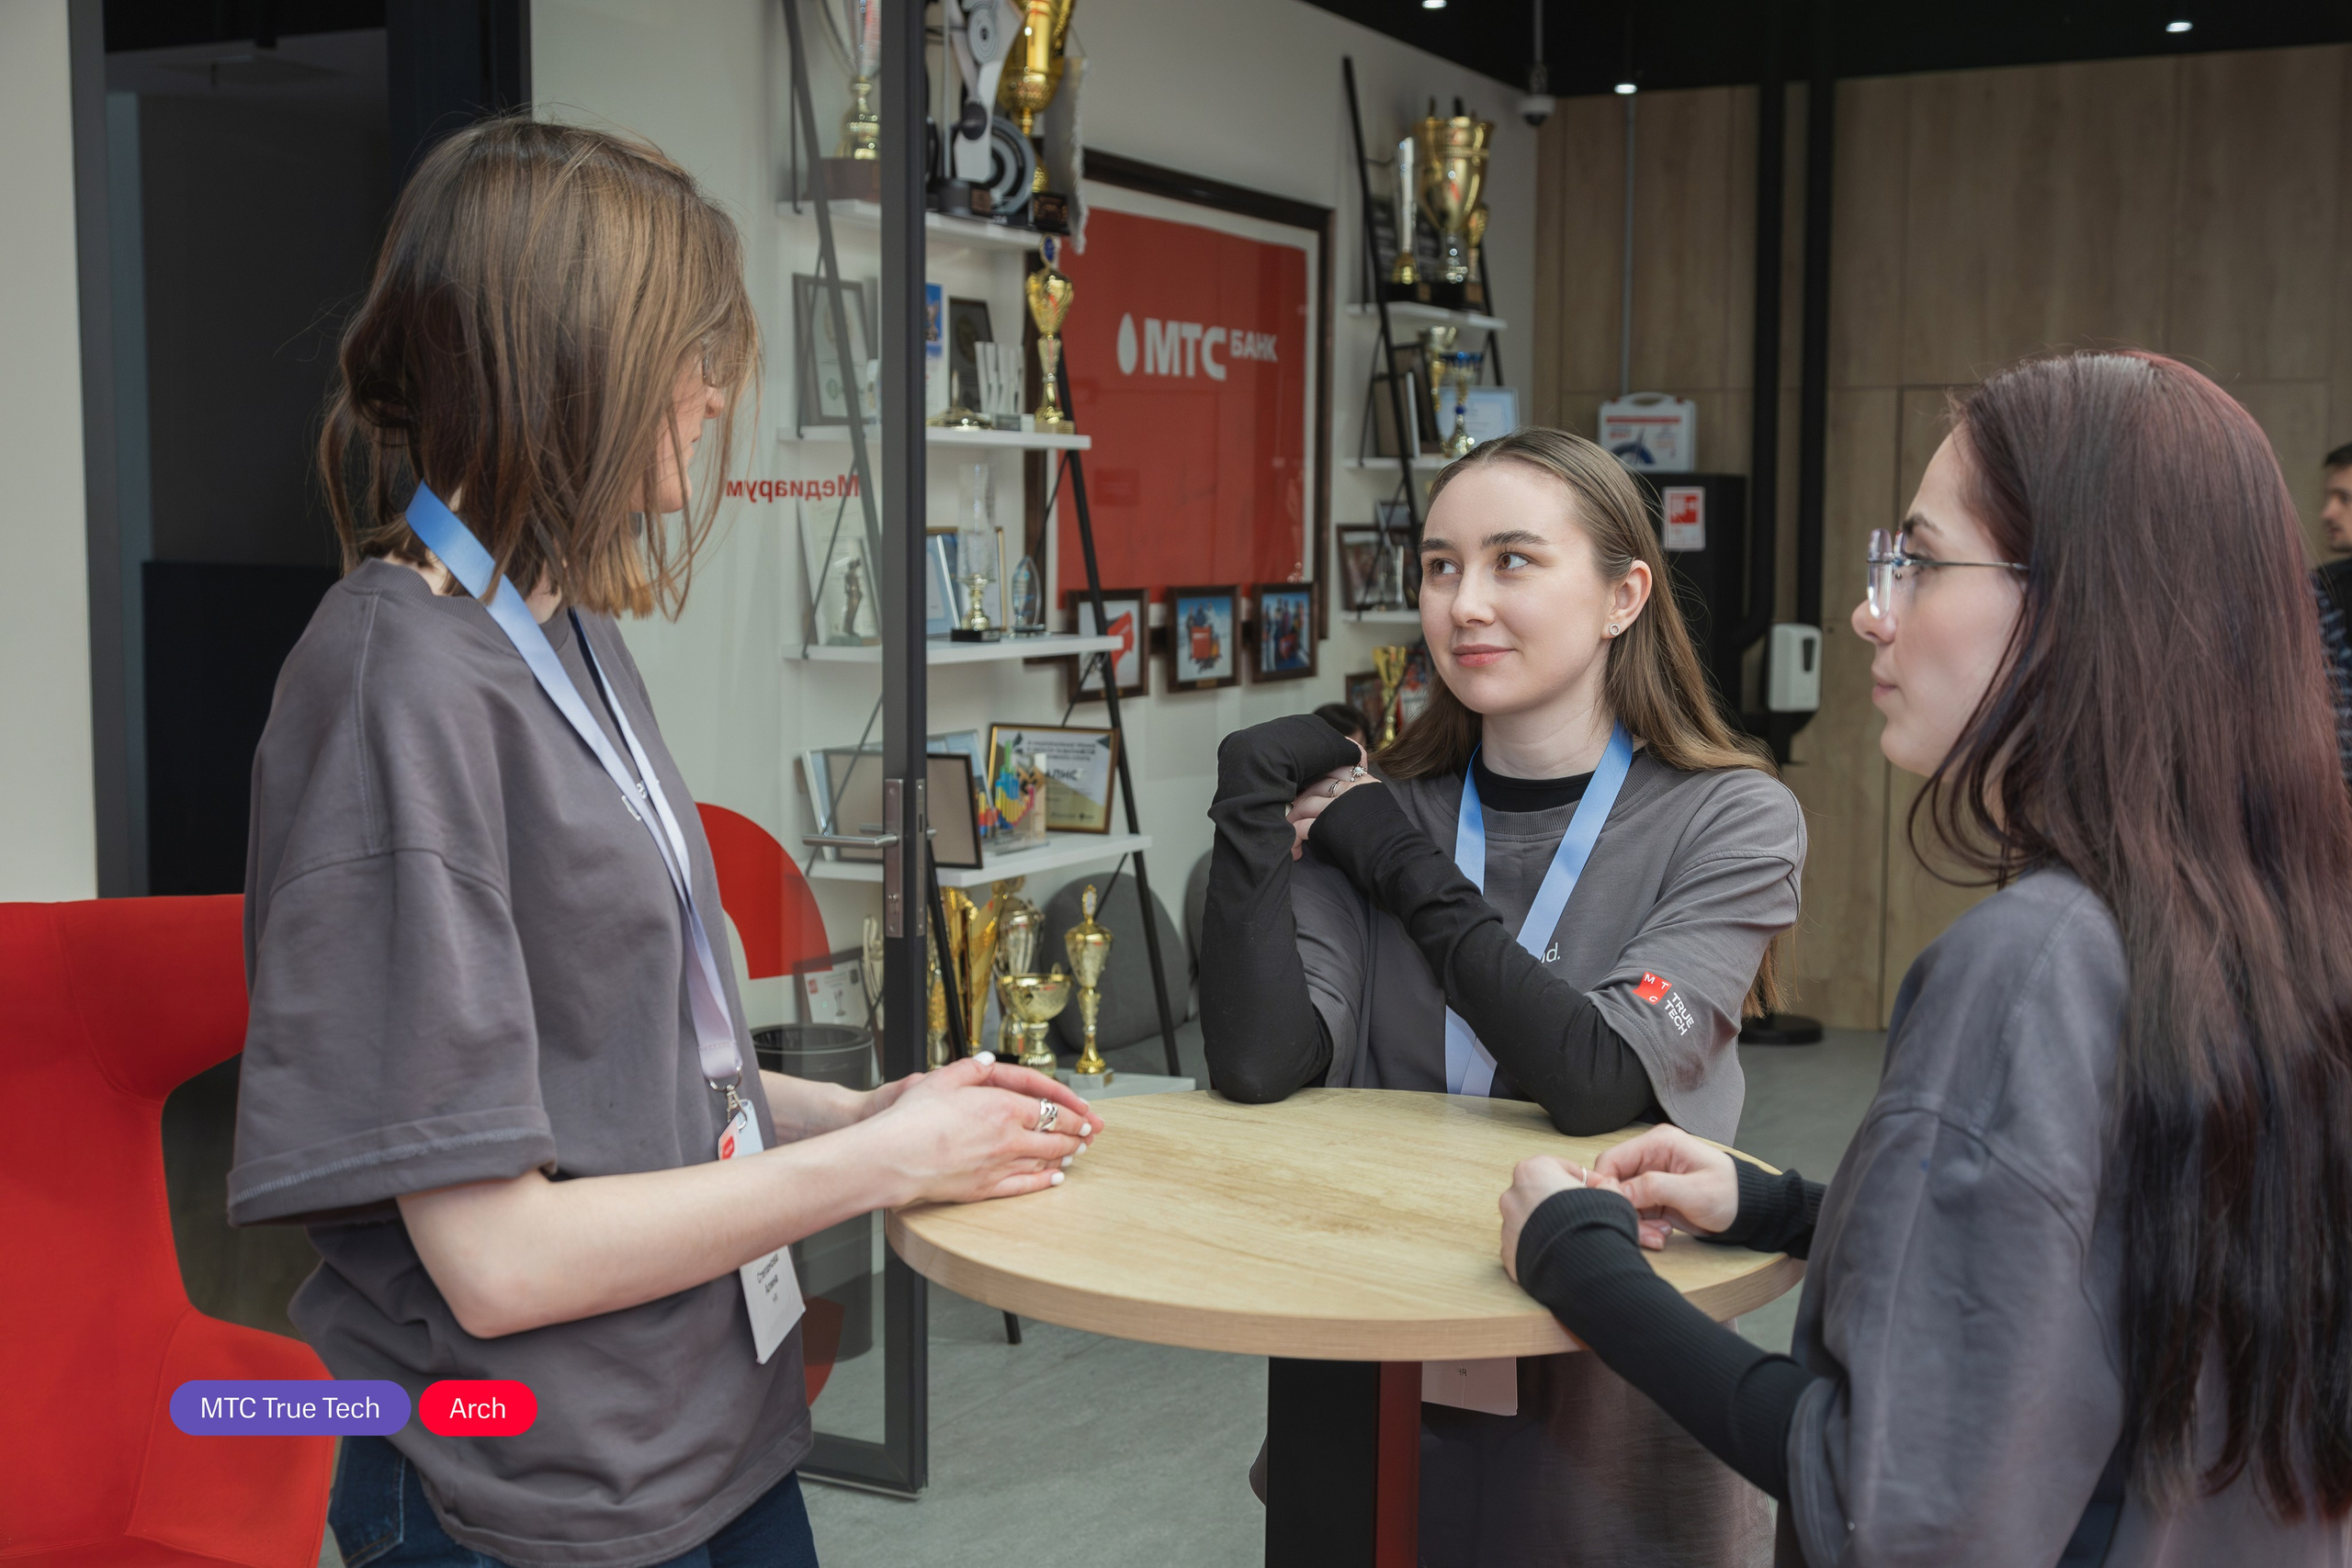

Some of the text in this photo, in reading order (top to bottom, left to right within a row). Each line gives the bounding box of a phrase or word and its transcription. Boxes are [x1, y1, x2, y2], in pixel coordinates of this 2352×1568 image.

[1144, 317, 1278, 381] МТС БАНК
[1664, 999, 1688, 1036] TECH
[1672, 992, 1695, 1028] TRUE
